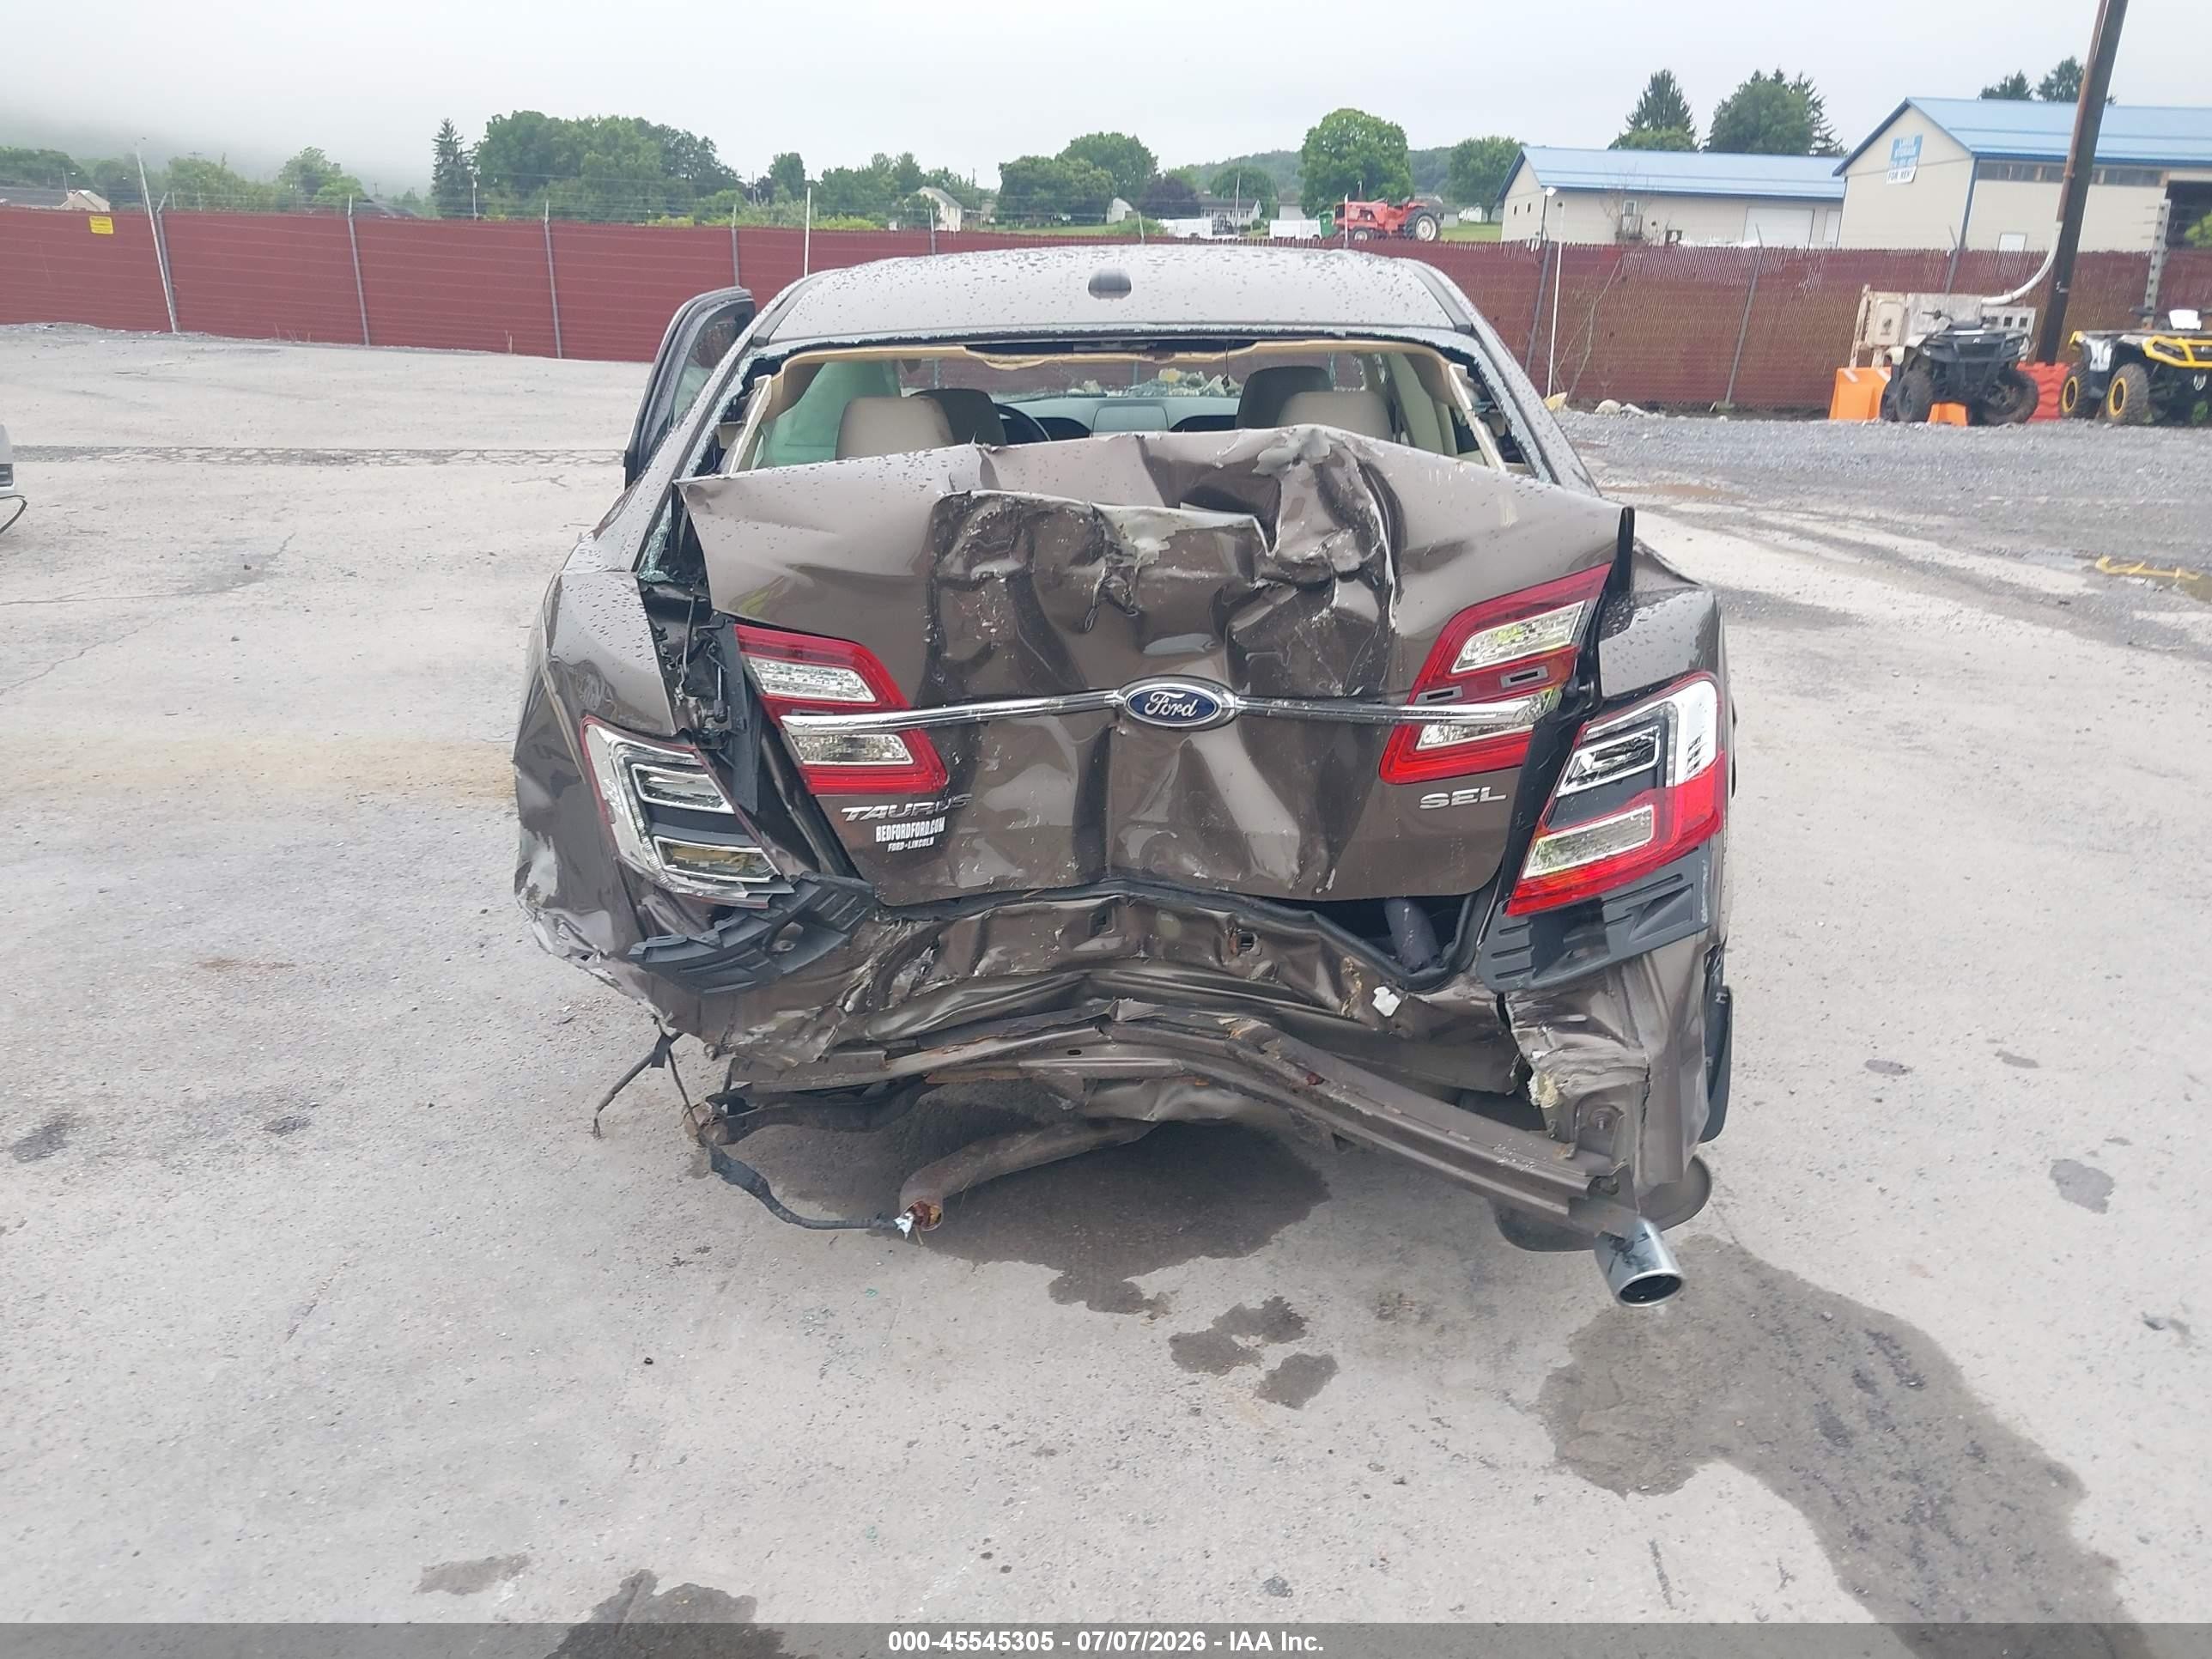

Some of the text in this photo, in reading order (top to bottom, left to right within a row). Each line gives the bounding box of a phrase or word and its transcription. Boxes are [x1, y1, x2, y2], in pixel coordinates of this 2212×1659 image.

[1144, 690, 1199, 717] Ford
[841, 793, 973, 822] TAURUS
[1419, 787, 1506, 809] SEL
[875, 817, 946, 842] BEDFORDFORD.COM
